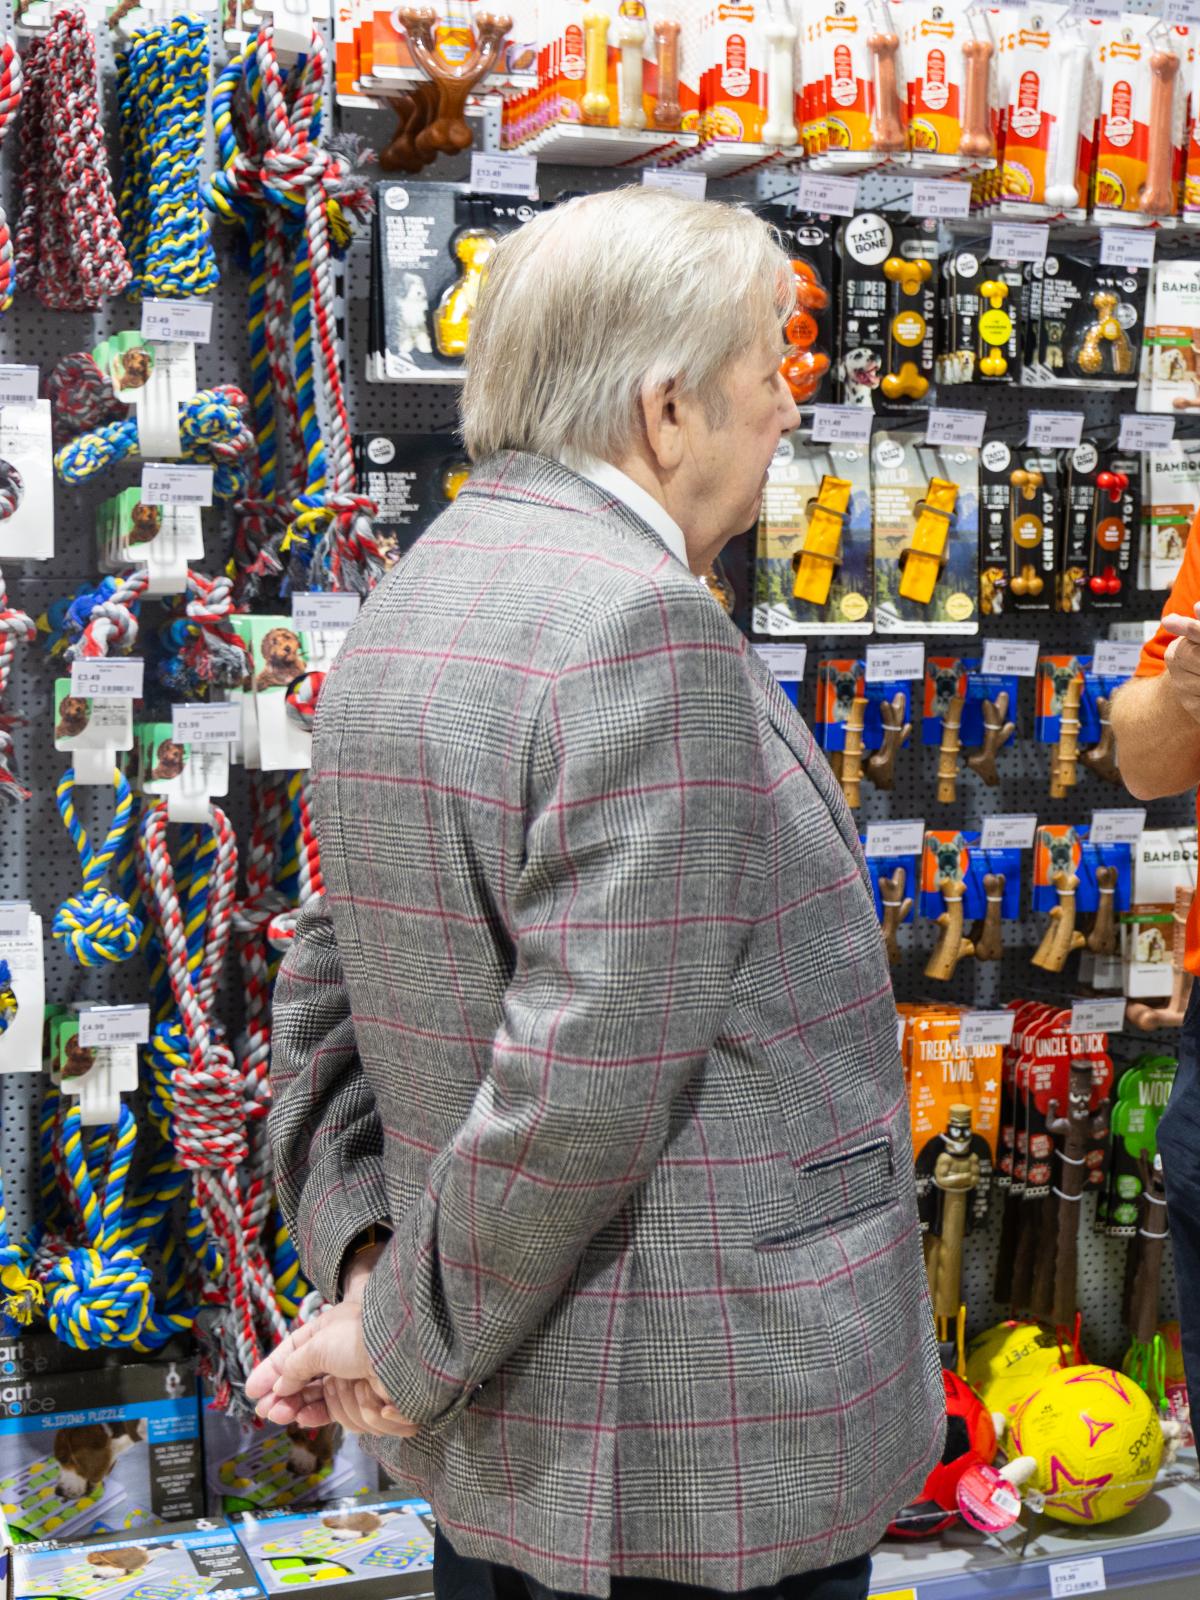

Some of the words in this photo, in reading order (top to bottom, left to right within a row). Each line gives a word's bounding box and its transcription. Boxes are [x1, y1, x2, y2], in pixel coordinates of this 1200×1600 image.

[850, 226, 887, 243] TASTY
[855, 239, 888, 254] BONE
[847, 280, 886, 295] SUPER
[847, 295, 886, 310] TOUGH
[924, 290, 935, 320] TOY
[922, 327, 934, 370] CHEW
[985, 450, 1006, 460] TASTY
[988, 456, 1006, 465] BONE
[1042, 493, 1053, 523] TOY
[1122, 495, 1133, 522] TOY
[1043, 528, 1053, 571] CHEW
[1119, 530, 1131, 571] CHEW
[1036, 1038, 1067, 1058] UNCLE
[1071, 1034, 1104, 1053] CHUCK
[941, 1060, 974, 1083] TWIG
[42, 1413, 86, 1427] SLIDING
[87, 1408, 126, 1422] PUZZLE
